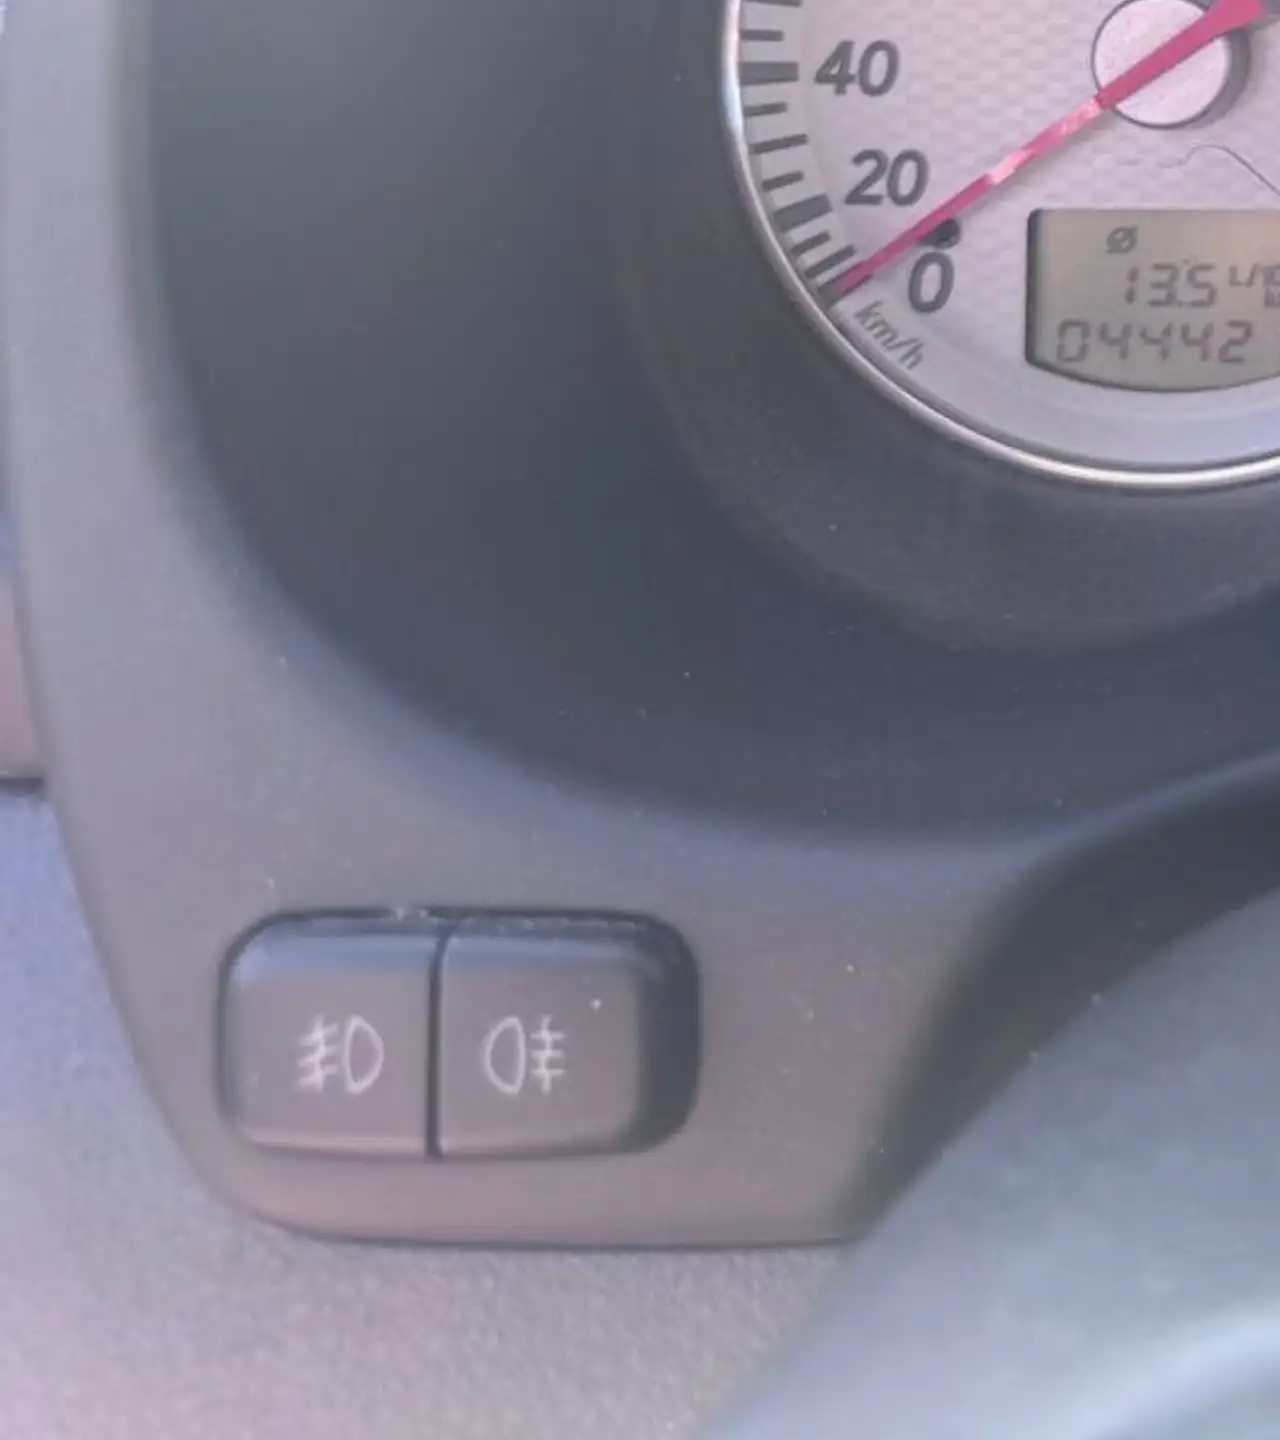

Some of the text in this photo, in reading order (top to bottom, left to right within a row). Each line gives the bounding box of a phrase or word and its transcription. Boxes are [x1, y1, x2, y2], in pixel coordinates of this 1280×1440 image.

[812, 39, 900, 98] 40
[842, 148, 930, 207] 20
[908, 251, 955, 314] 0
[853, 299, 924, 370] km/h
